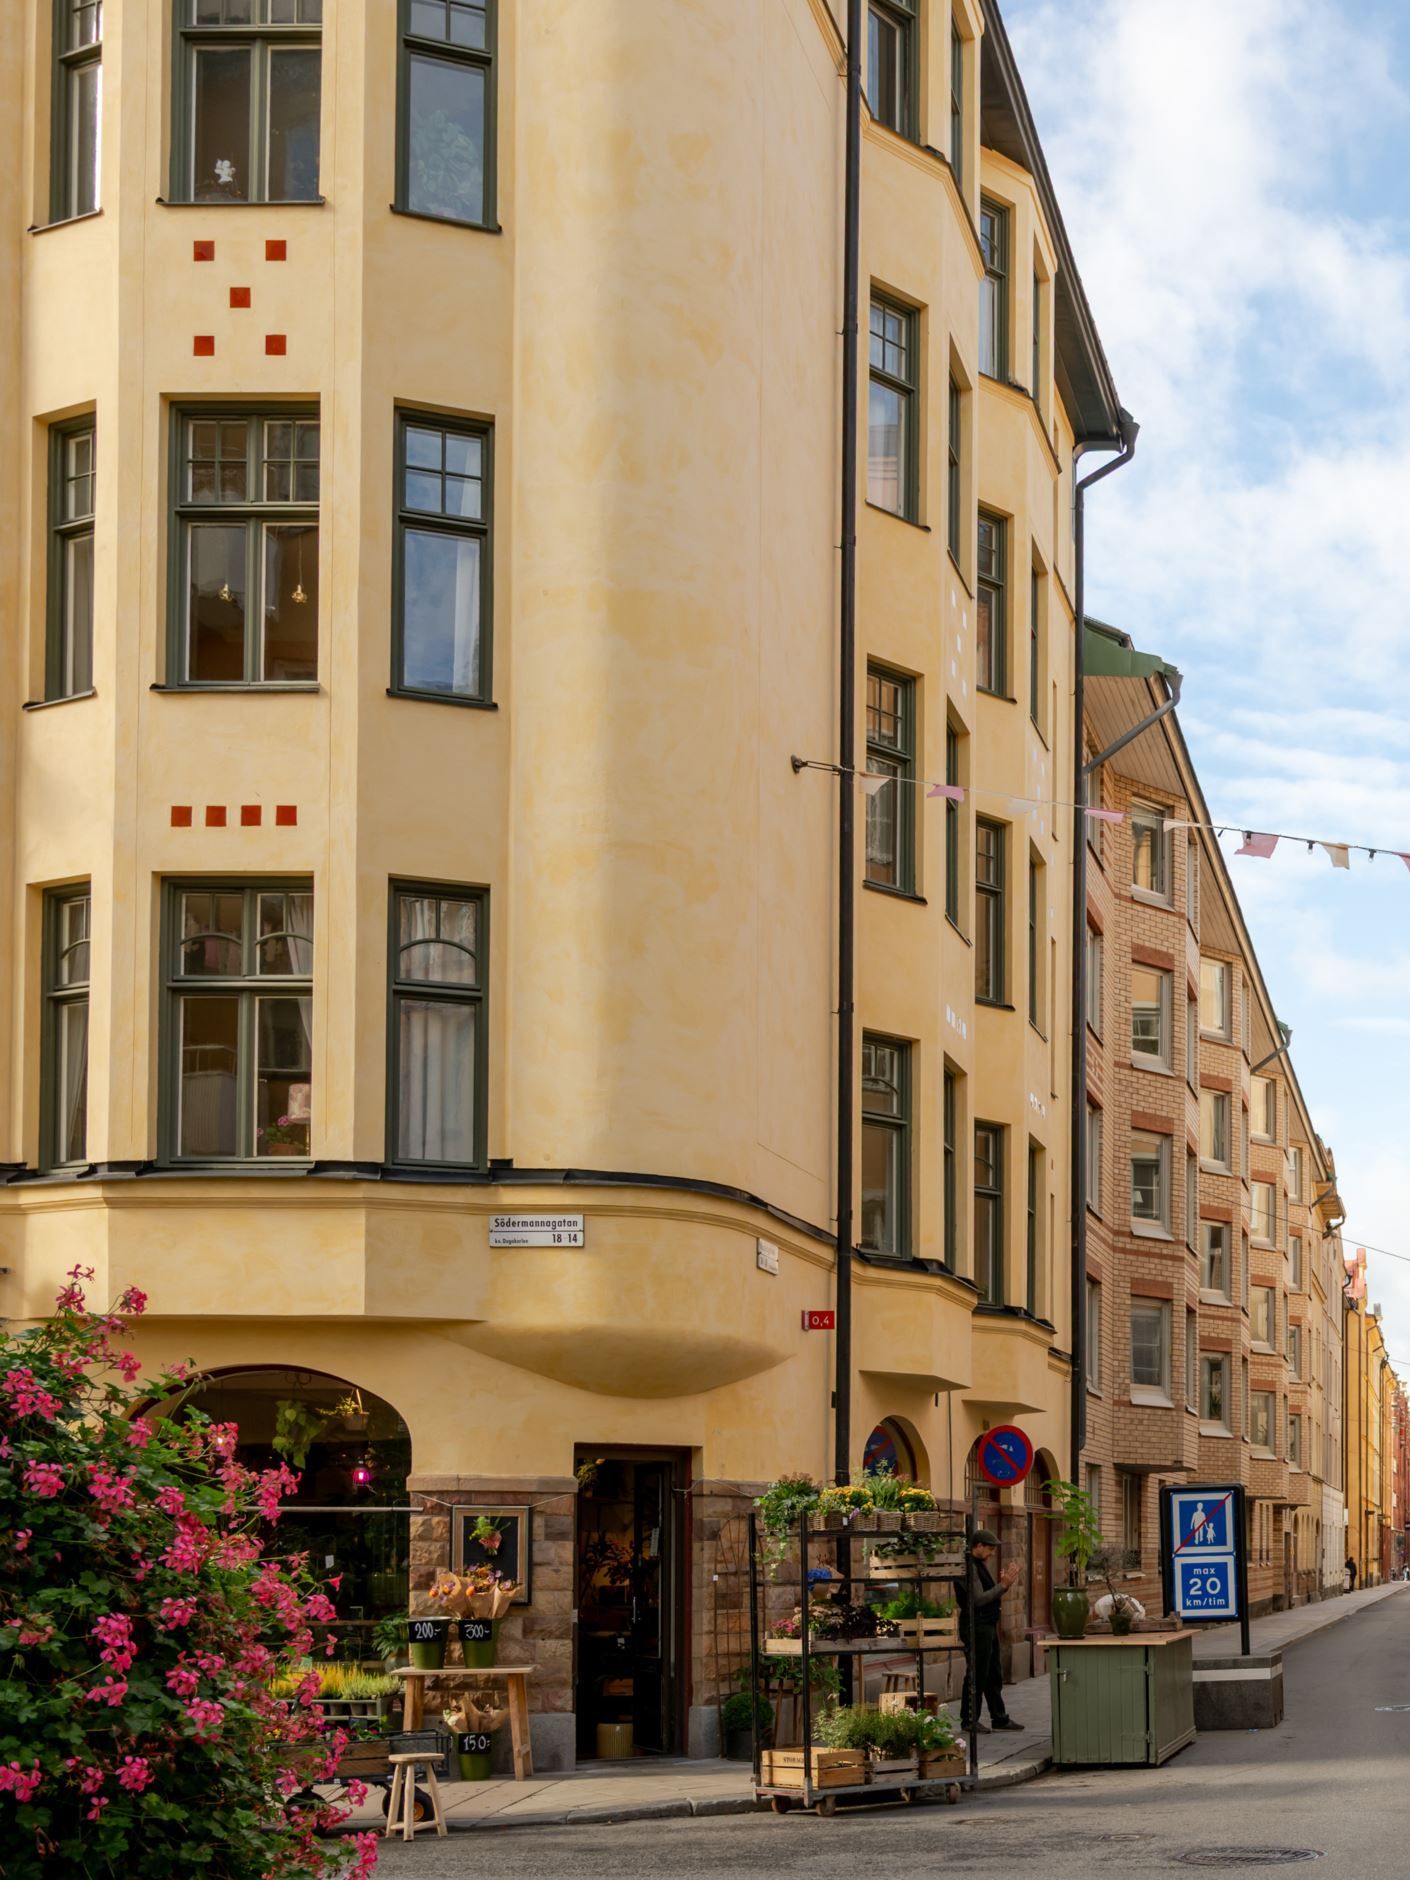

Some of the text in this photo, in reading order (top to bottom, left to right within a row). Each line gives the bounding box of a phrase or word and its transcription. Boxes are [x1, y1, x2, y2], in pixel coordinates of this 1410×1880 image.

[494, 1217, 578, 1230] Södermannagatan
[552, 1233, 562, 1243] 18
[567, 1233, 578, 1243] 14
[1189, 1577, 1221, 1596] 20
[1186, 1597, 1225, 1607] km/tim
